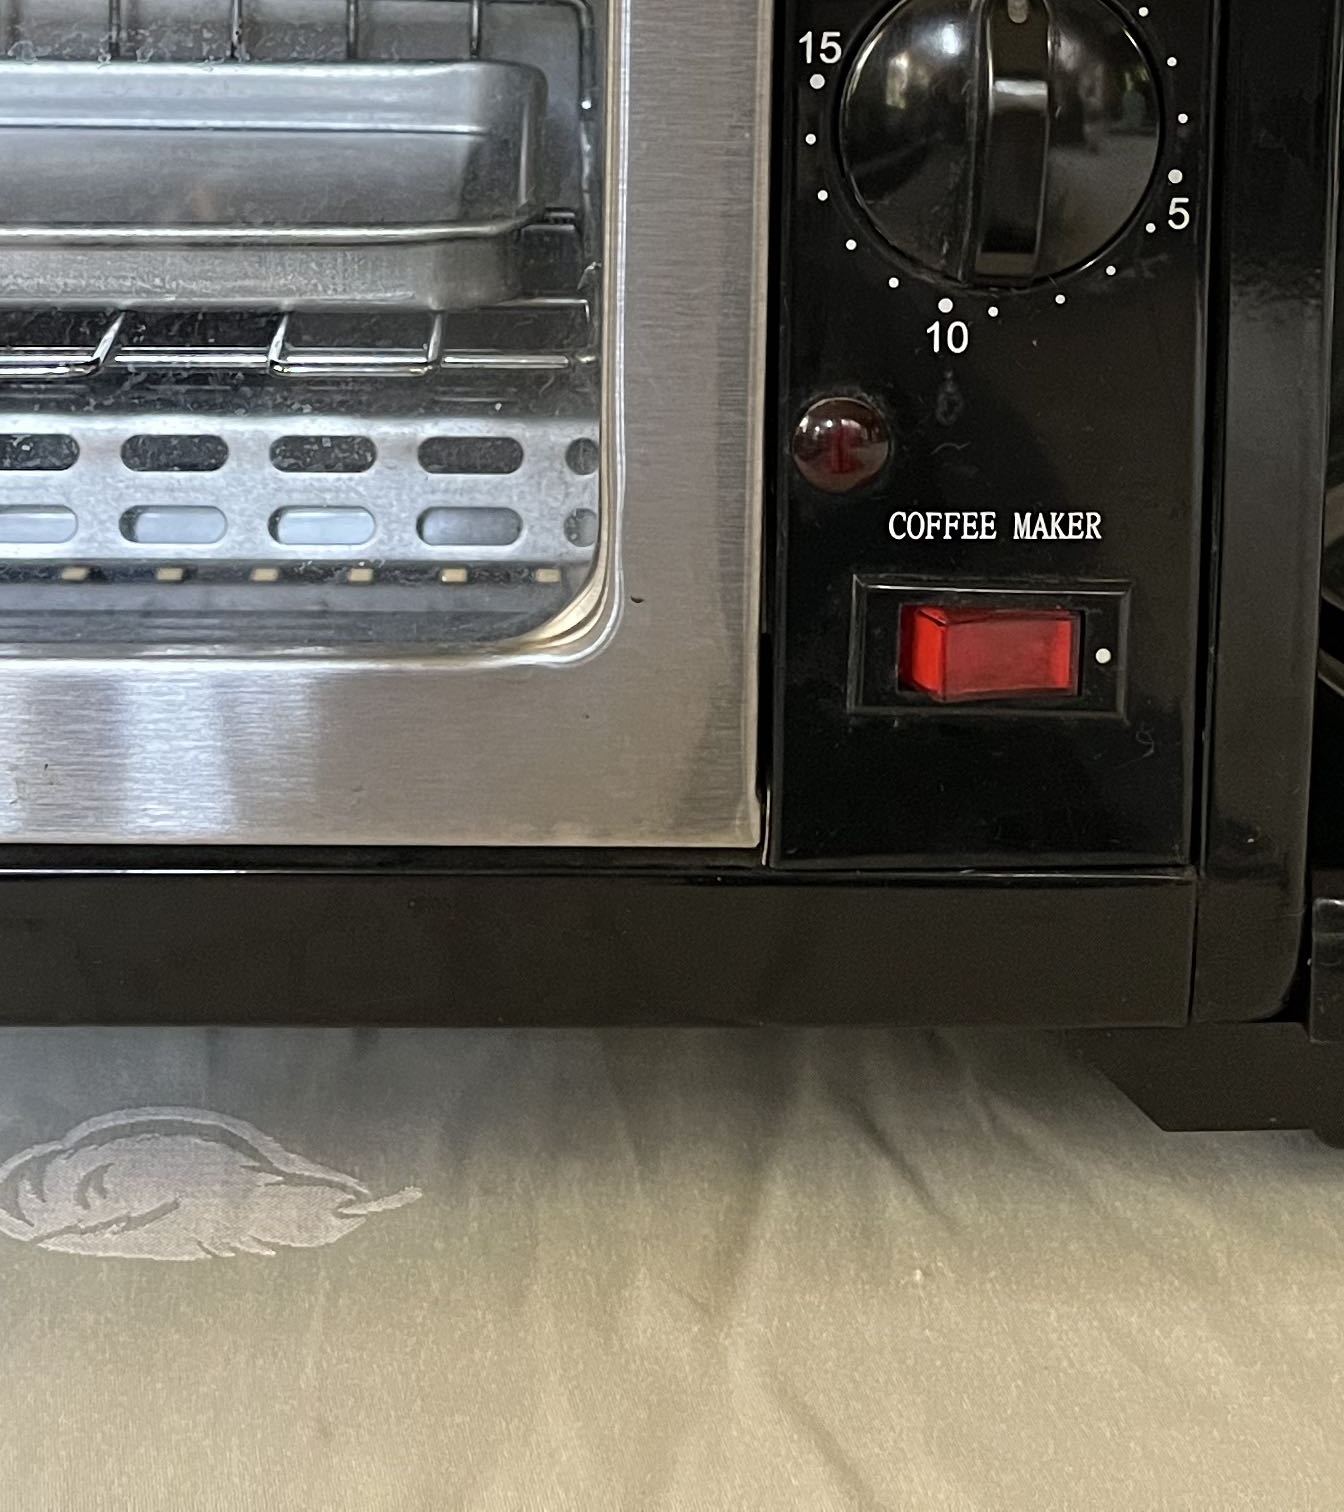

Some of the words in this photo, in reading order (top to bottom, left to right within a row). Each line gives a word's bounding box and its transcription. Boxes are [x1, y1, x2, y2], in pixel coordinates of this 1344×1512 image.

[799, 31, 842, 64] 15
[1168, 198, 1190, 230] 5
[927, 321, 969, 353] 10
[889, 512, 997, 540] COFFEE
[1013, 512, 1102, 540] MAKER
